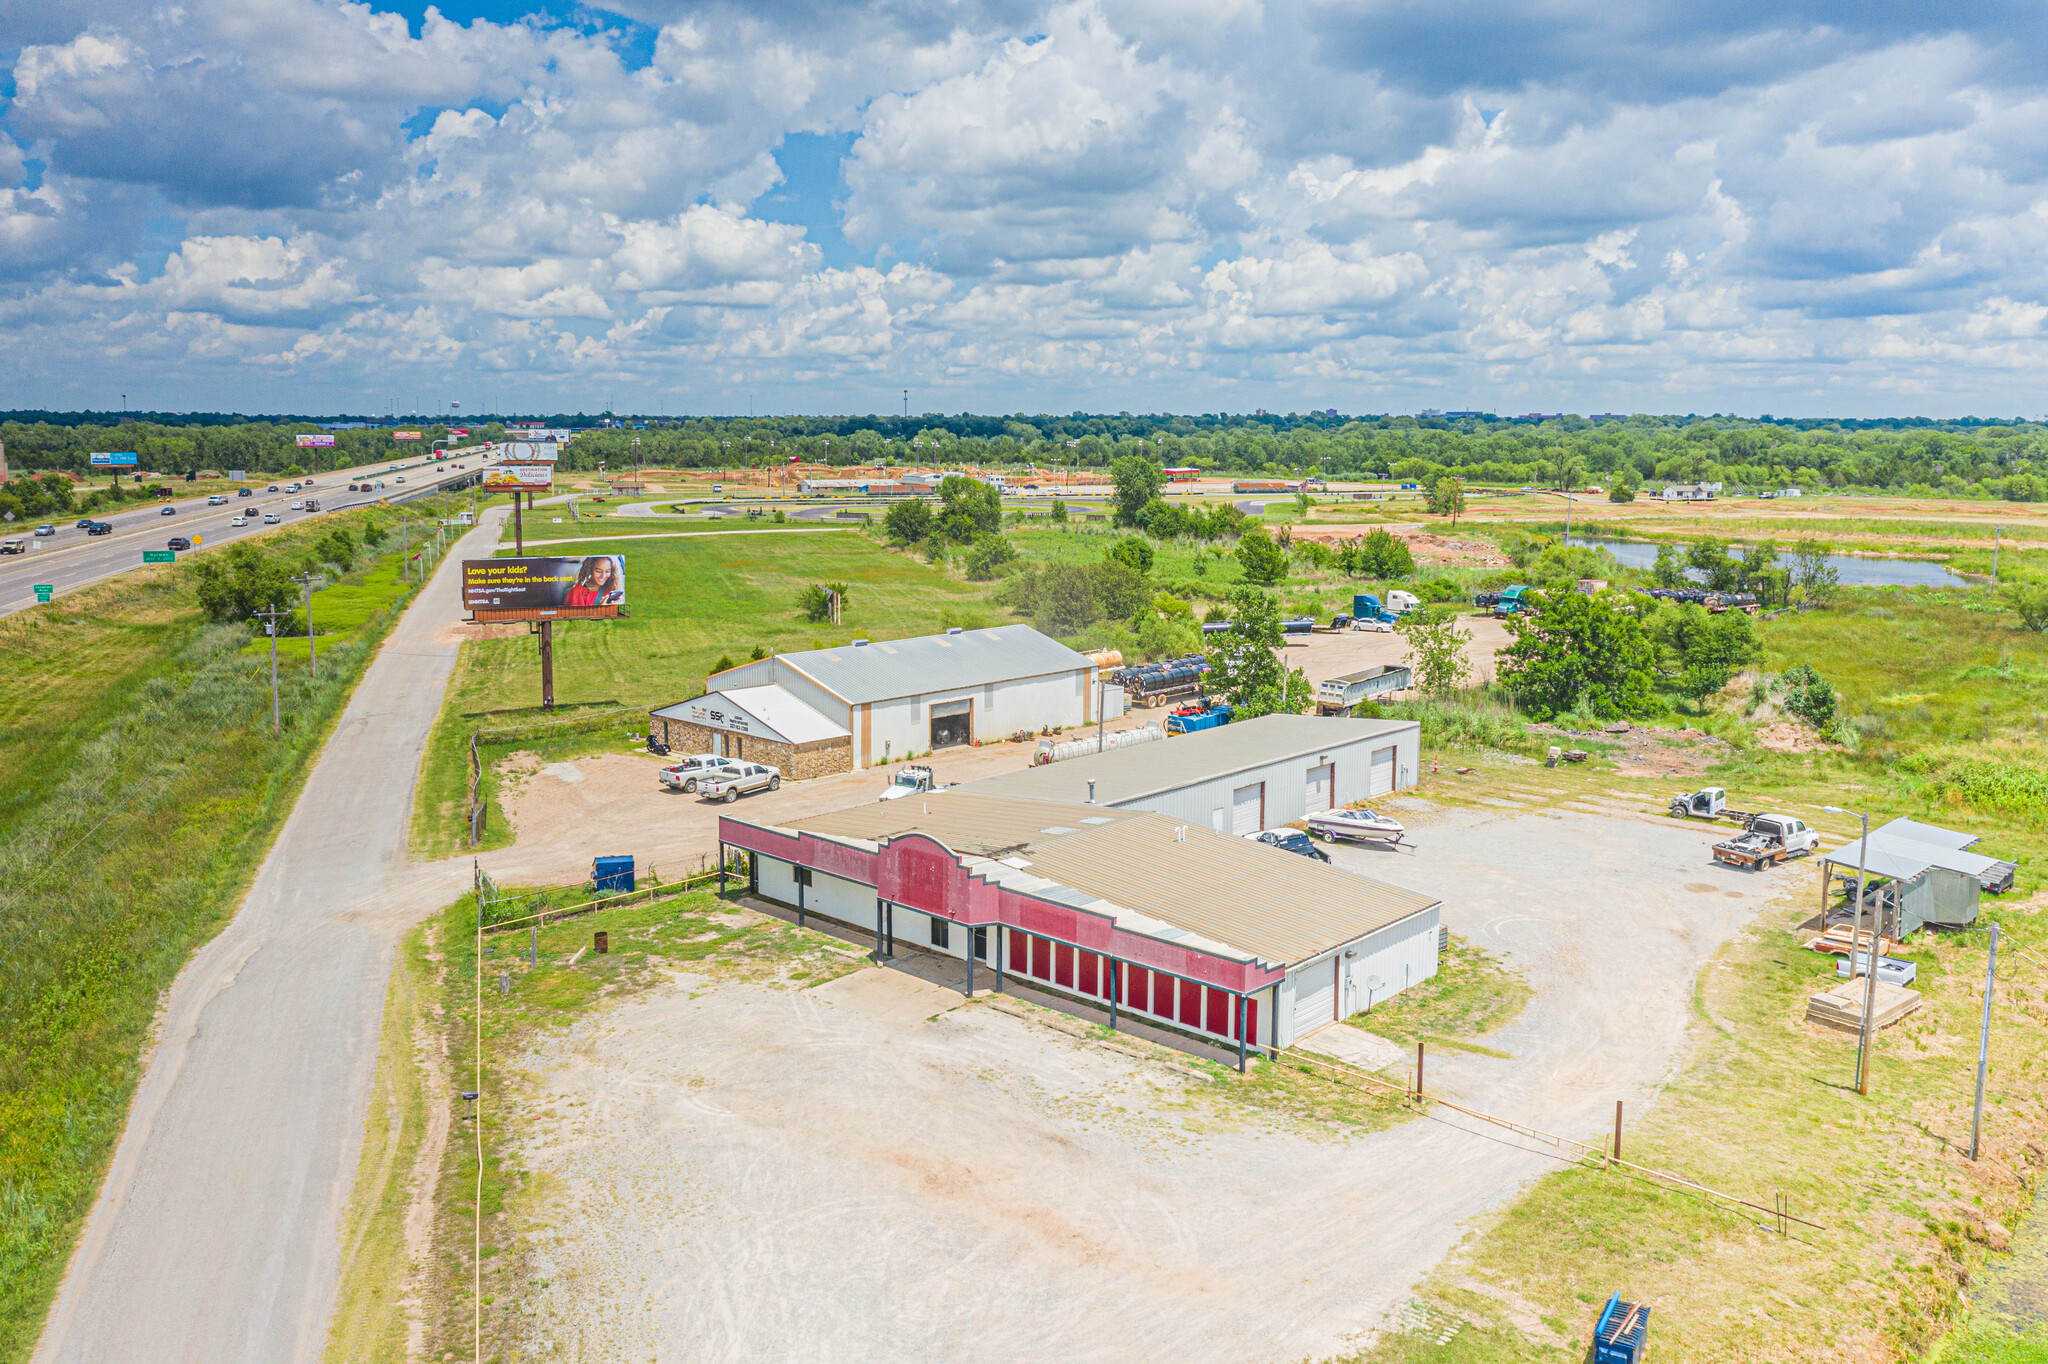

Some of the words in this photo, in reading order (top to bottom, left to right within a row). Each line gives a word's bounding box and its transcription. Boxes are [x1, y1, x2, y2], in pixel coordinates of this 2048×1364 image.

[467, 567, 487, 575] Love
[488, 567, 506, 576] your
[507, 565, 528, 574] kids?
[502, 576, 523, 584] they're
